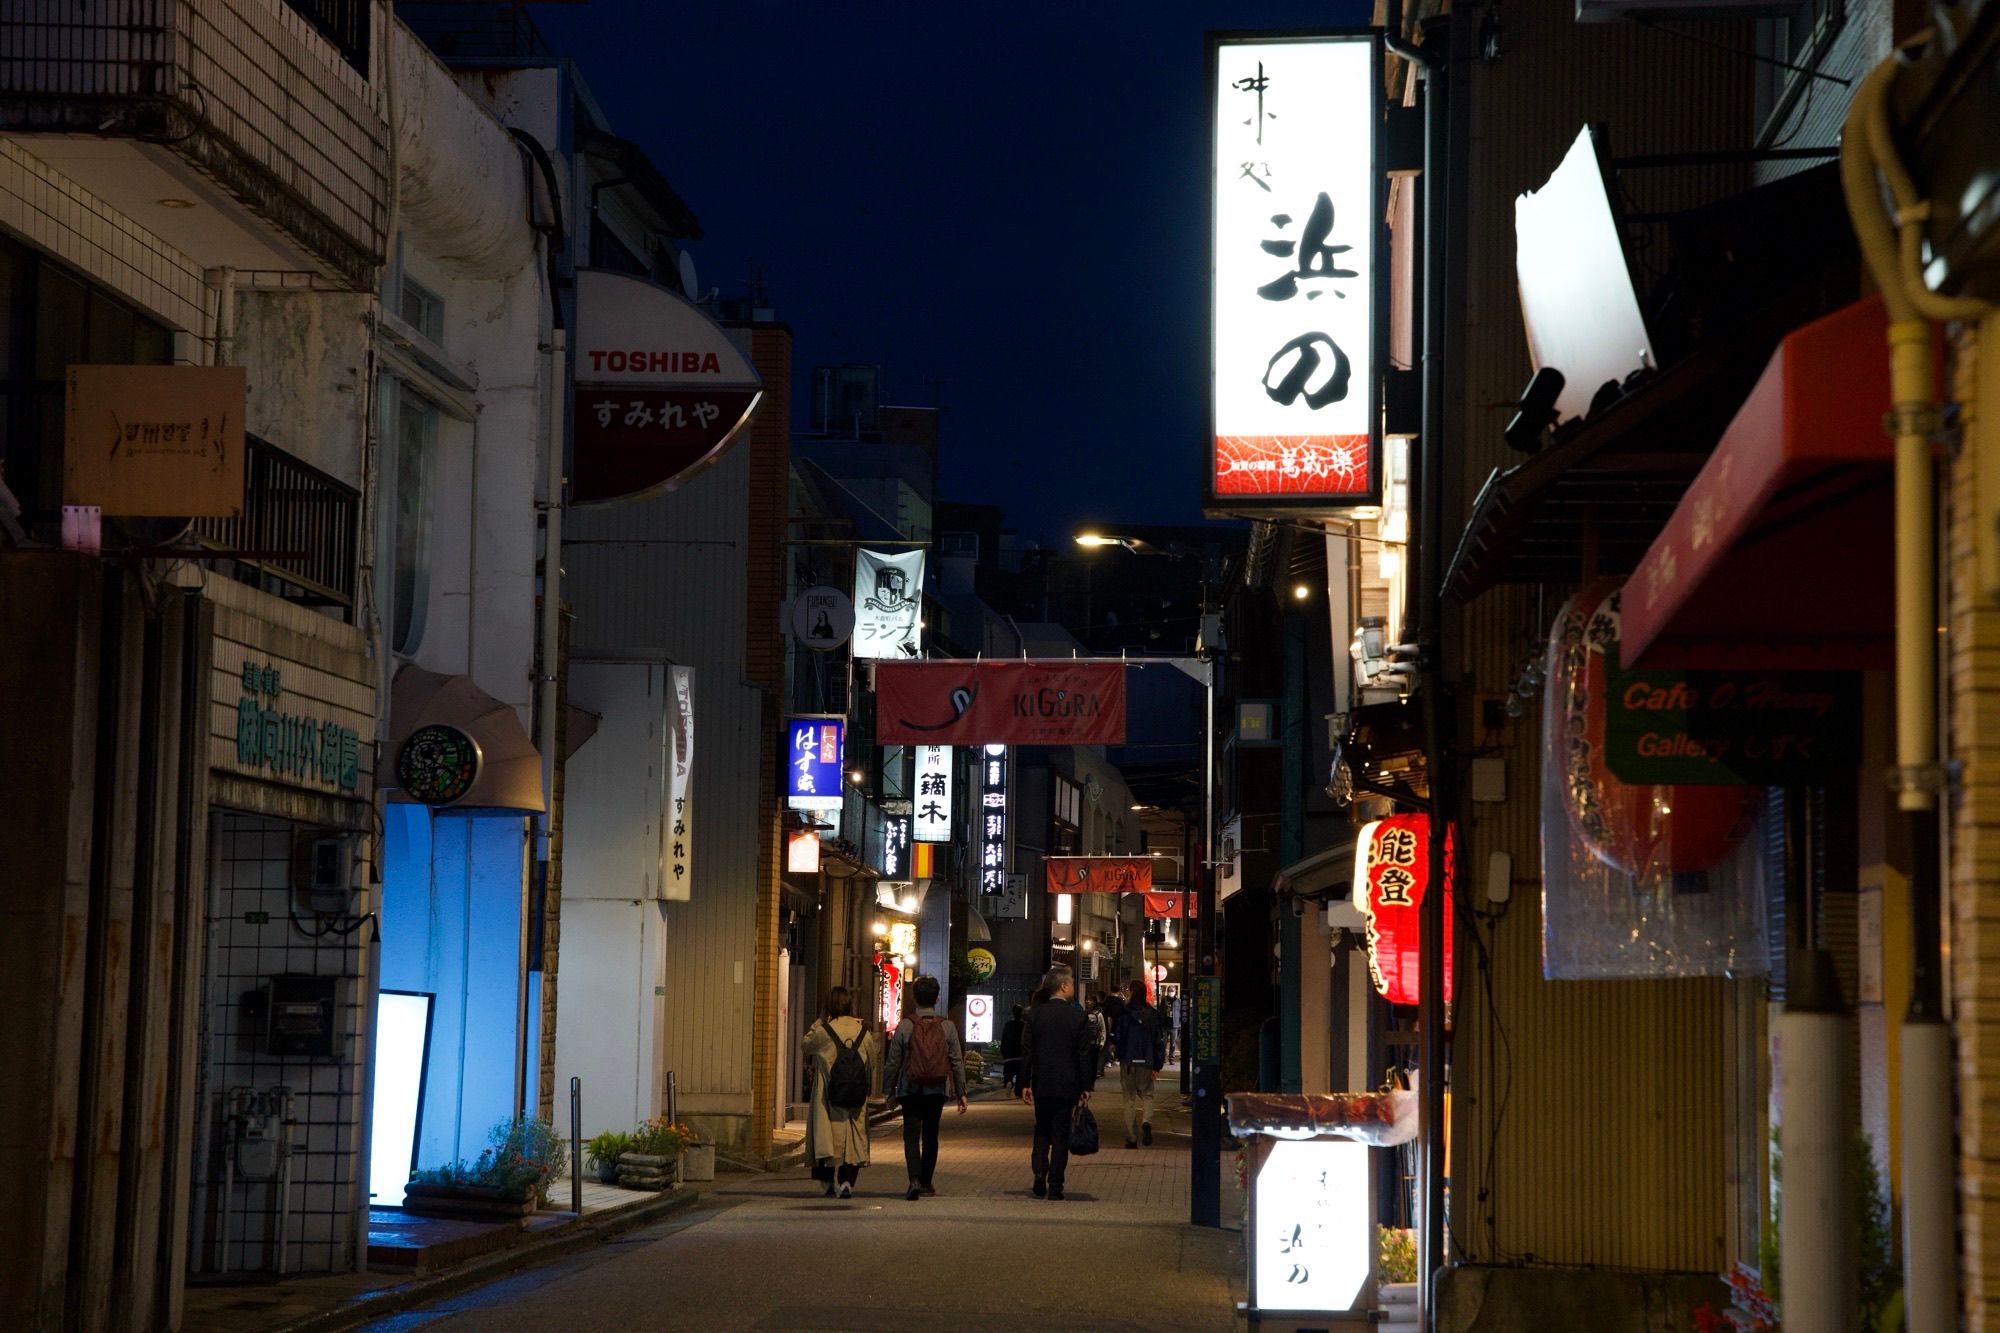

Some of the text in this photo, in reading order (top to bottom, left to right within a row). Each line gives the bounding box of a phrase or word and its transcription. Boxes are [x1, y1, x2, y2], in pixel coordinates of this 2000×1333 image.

[1257, 191, 1358, 410] 浜の
[589, 351, 721, 373] TOSHIBA
[592, 400, 720, 430] すみれや
[861, 623, 915, 641] ランプ
[1013, 688, 1101, 717] KIGURA
[1623, 682, 1698, 711] Cafe
[1636, 731, 1725, 764] Gallery
[673, 797, 686, 880] すみれや
[1104, 870, 1141, 881] KIGURA
[1379, 828, 1412, 904] 能登
